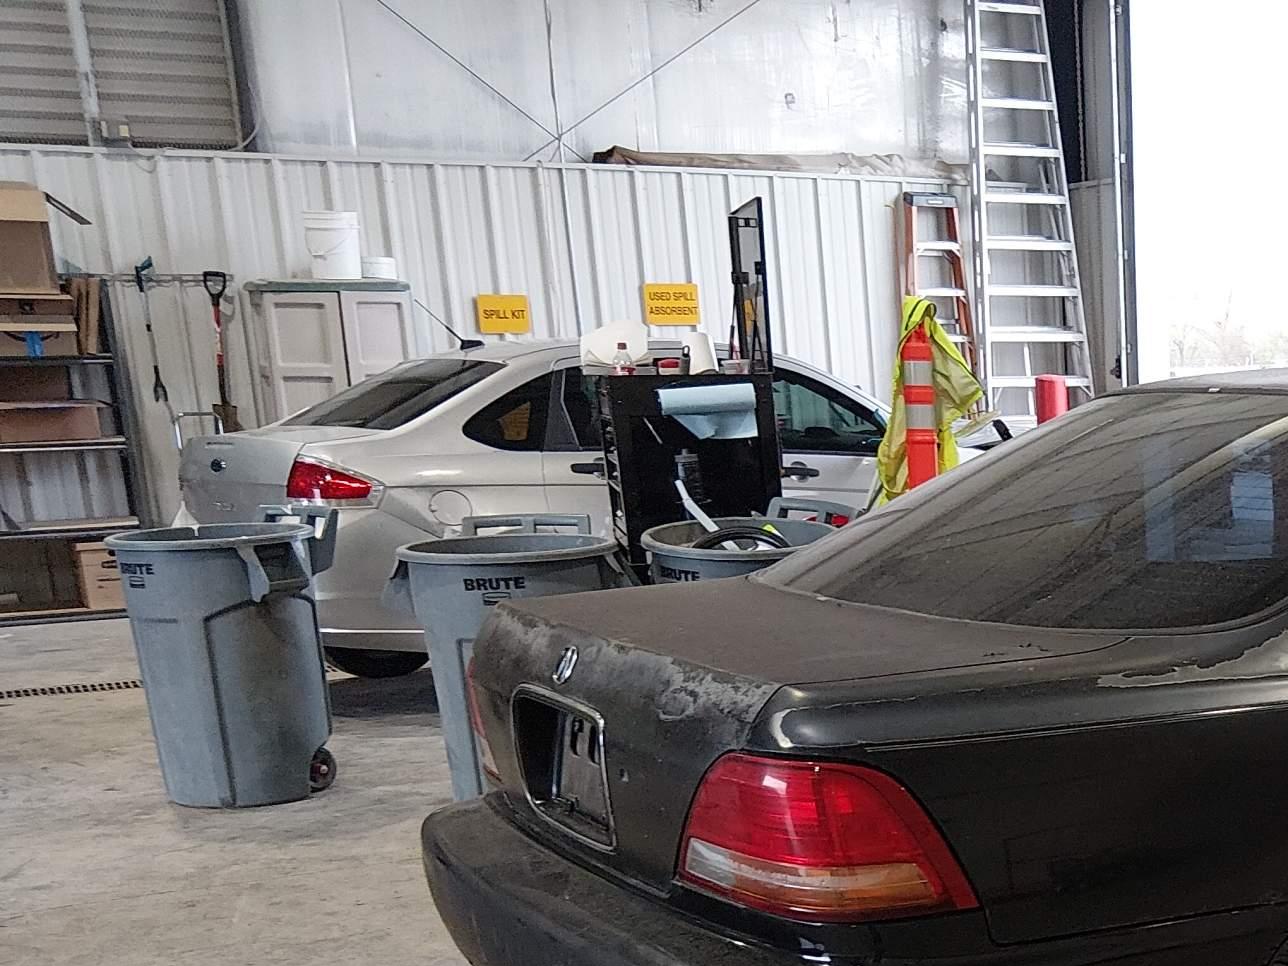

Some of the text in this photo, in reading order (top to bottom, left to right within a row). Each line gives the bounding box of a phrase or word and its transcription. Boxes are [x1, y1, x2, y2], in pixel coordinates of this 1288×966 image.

[648, 291, 697, 301] USED SPILL
[482, 309, 526, 319] SPILL KIT
[649, 305, 698, 316] ABSORBENT
[463, 576, 526, 592] BRUTE
